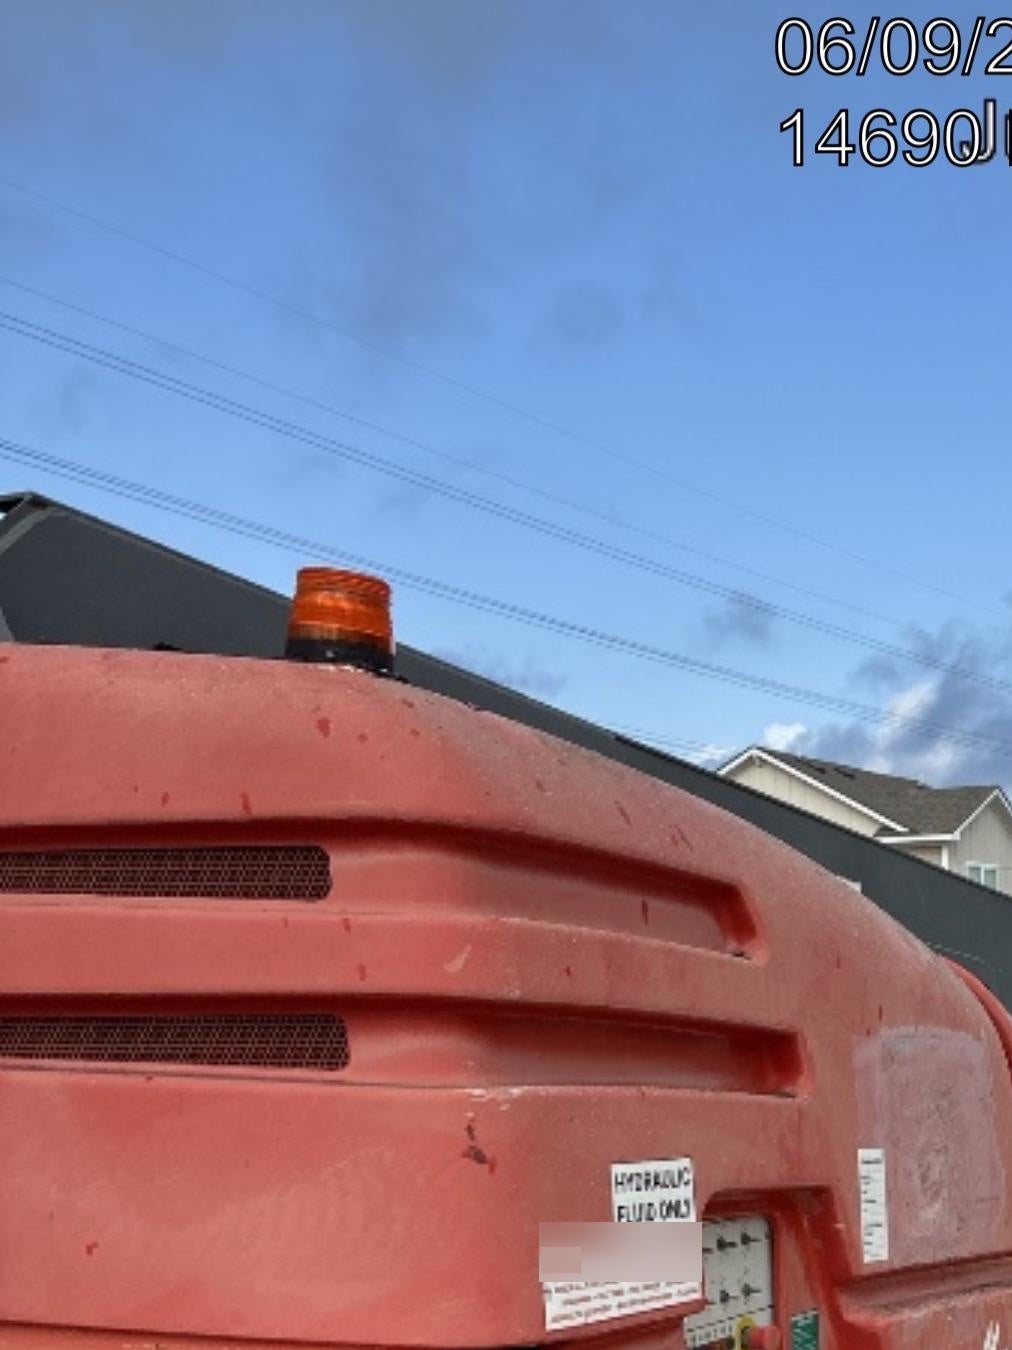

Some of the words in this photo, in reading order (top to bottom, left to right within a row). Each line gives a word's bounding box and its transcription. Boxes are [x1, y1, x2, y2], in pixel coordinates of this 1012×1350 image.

[614, 1166, 691, 1193] HYDRAULIC
[617, 1202, 658, 1222] FLUID
[660, 1198, 691, 1220] ONLY
